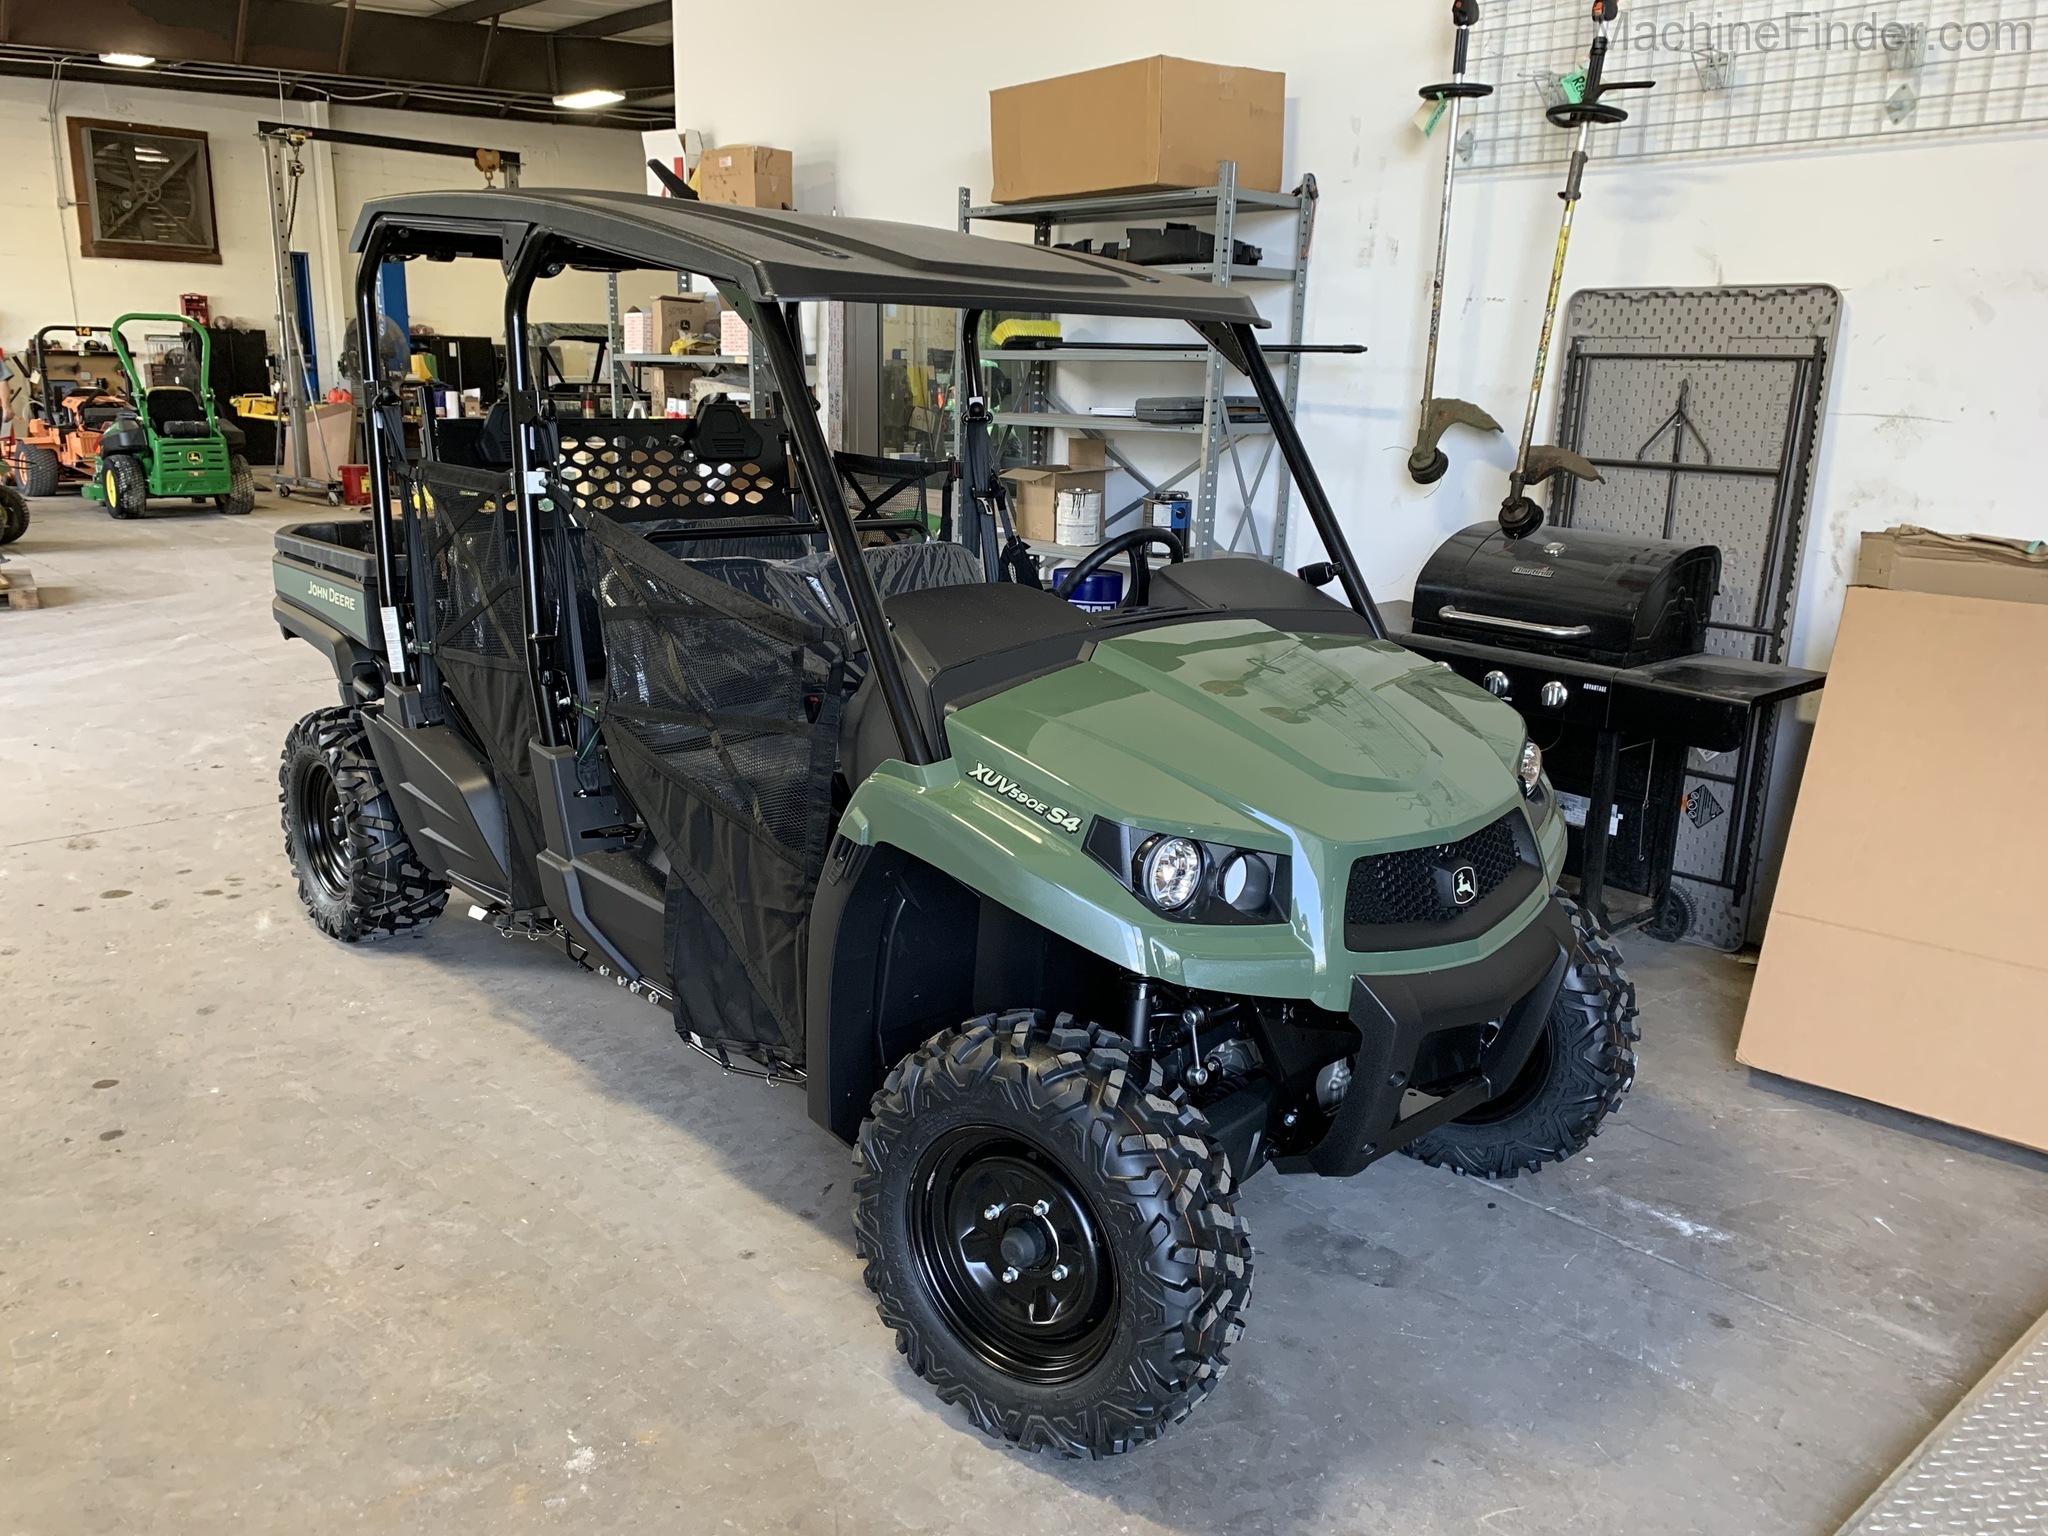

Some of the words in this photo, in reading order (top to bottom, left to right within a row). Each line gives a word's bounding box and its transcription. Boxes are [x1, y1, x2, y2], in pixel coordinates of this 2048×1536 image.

[76, 327, 91, 336] 14
[307, 581, 329, 601] JOHN
[328, 587, 356, 611] DEERE
[1583, 682, 1608, 693] ADVANTAGE
[966, 760, 1050, 815] XUV590E
[1045, 806, 1083, 834] S4
